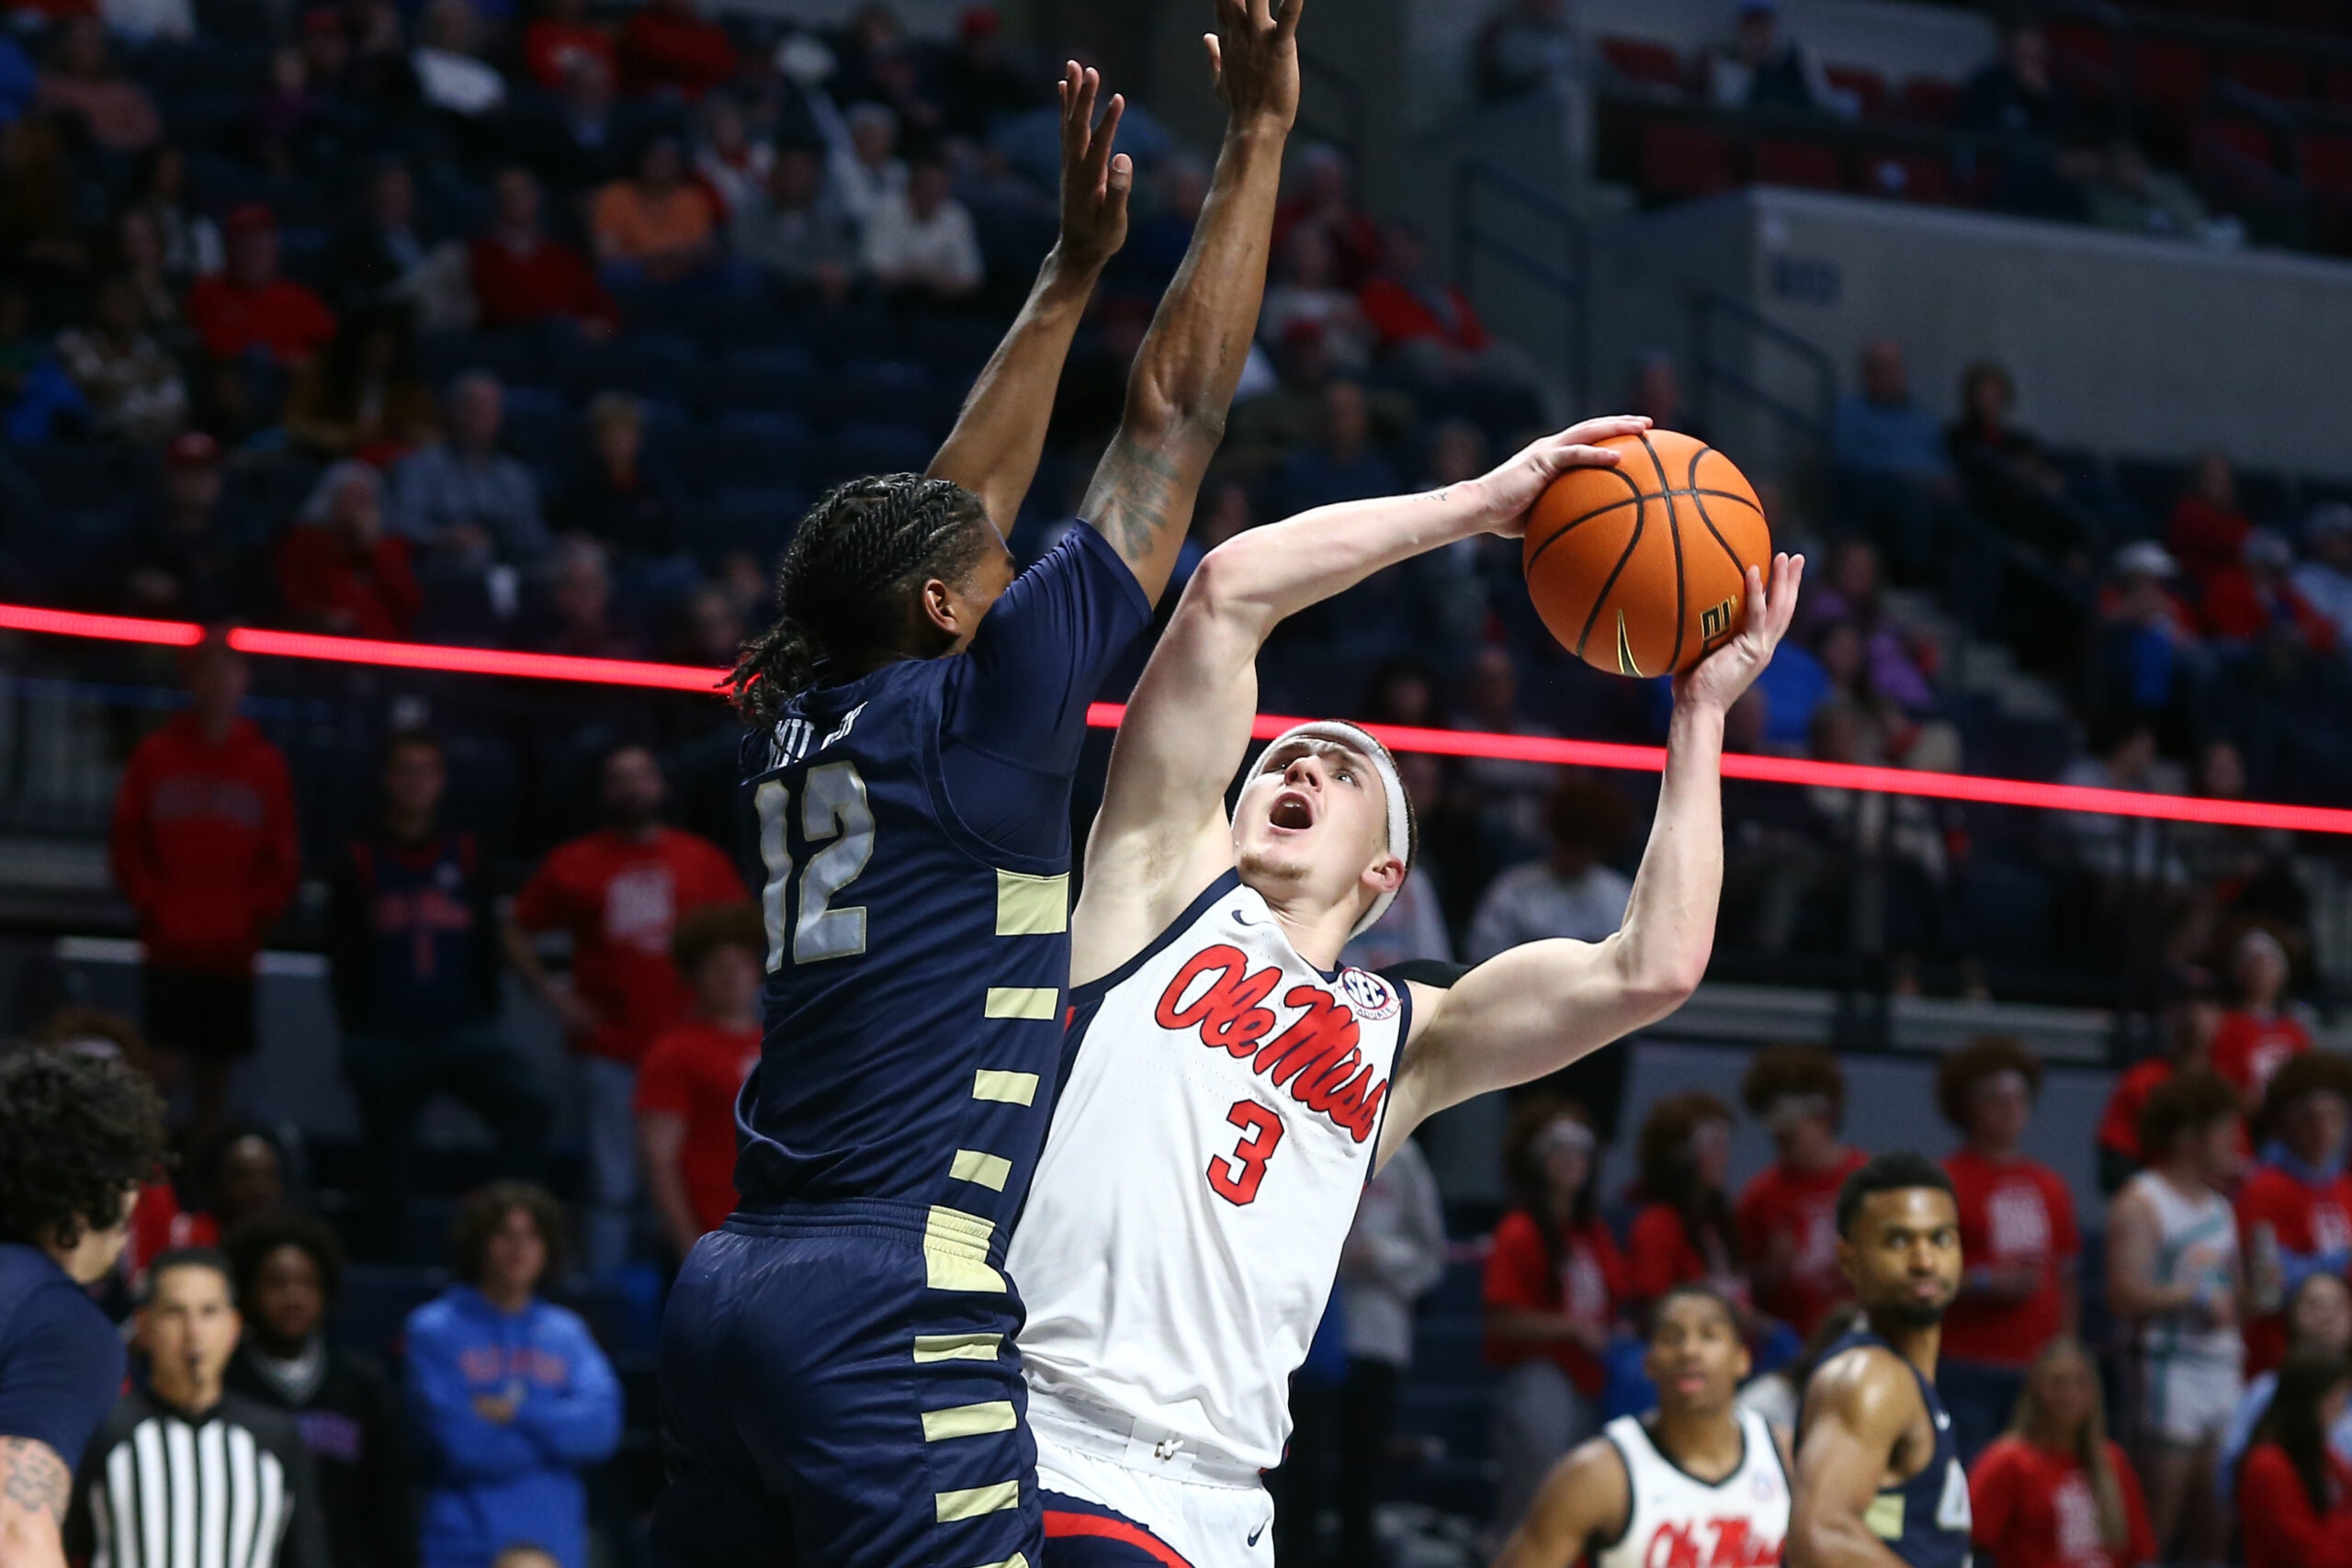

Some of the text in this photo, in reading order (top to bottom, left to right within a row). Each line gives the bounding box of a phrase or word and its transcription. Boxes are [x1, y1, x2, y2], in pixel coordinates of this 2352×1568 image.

[753, 760, 876, 975] 12
[1155, 943, 1388, 1144] Ole Miss
[1344, 970, 1385, 1009] SEC
[1206, 1099, 1284, 1206] 3
